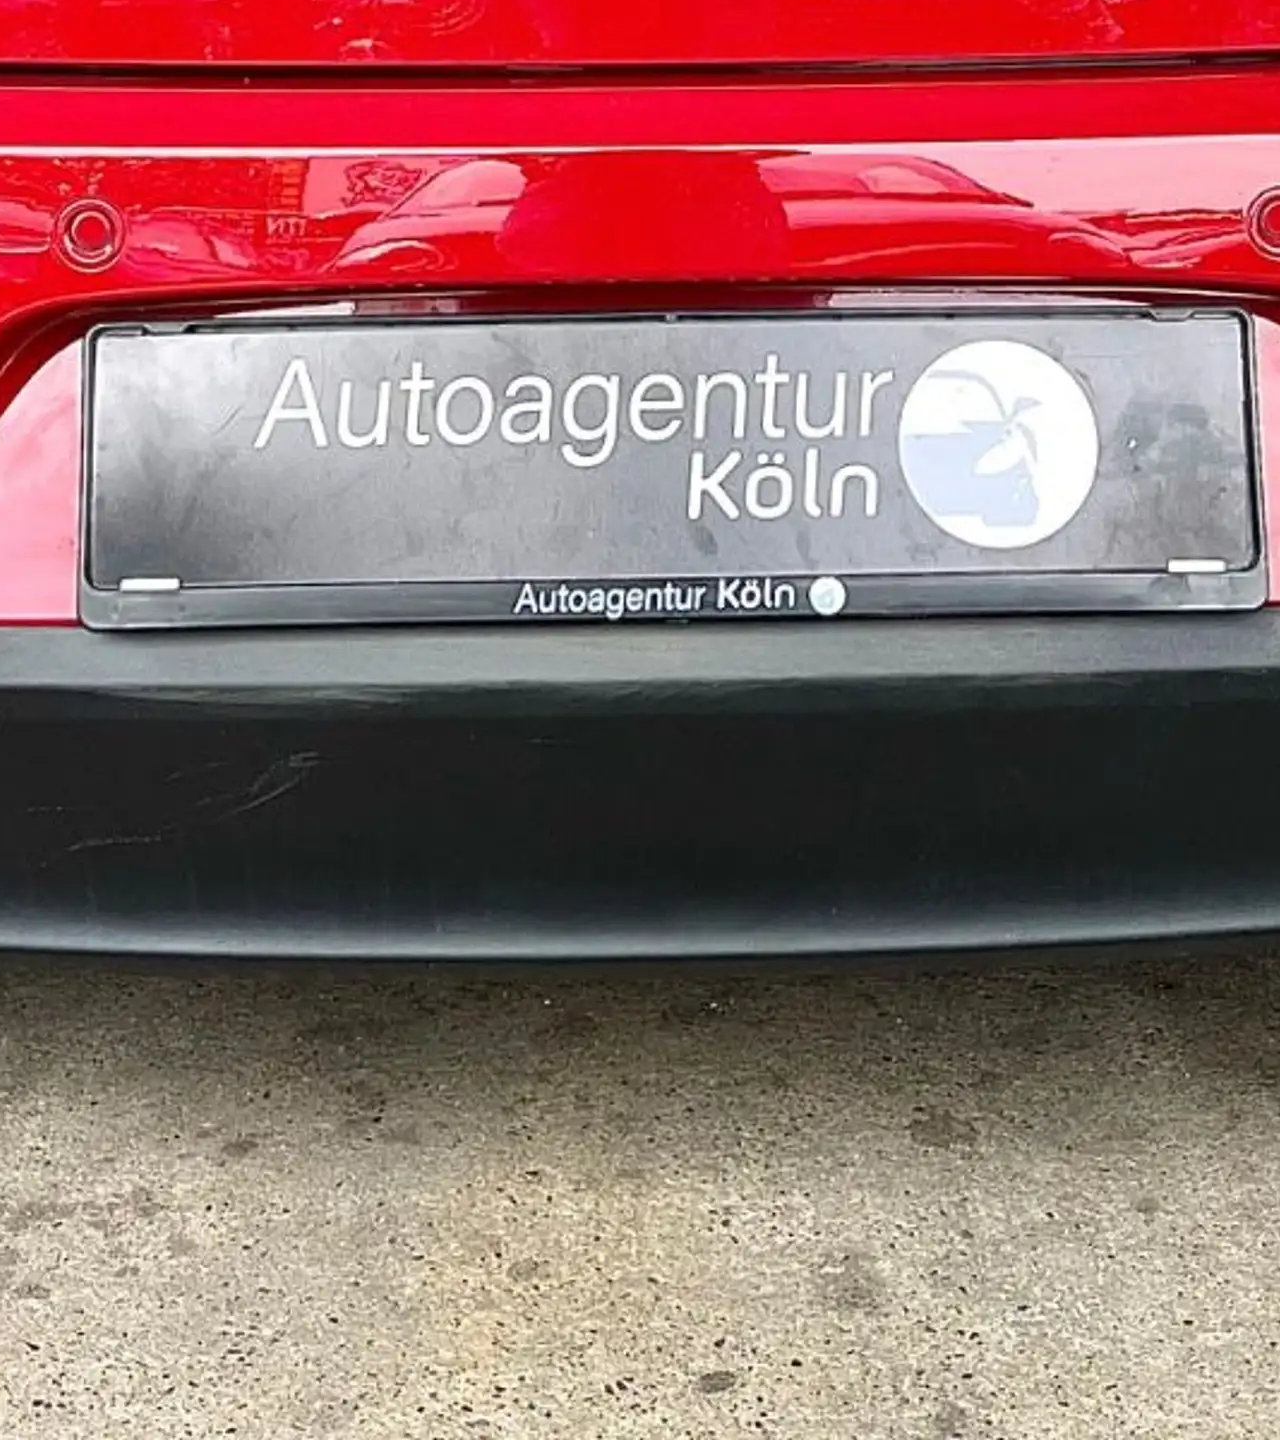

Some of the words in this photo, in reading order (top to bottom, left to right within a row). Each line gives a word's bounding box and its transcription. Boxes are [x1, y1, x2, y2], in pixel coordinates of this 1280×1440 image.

[253, 354, 894, 468] Autoagentur
[686, 448, 879, 520] Köln
[514, 581, 707, 621] Autoagentur
[717, 578, 796, 610] Köln
